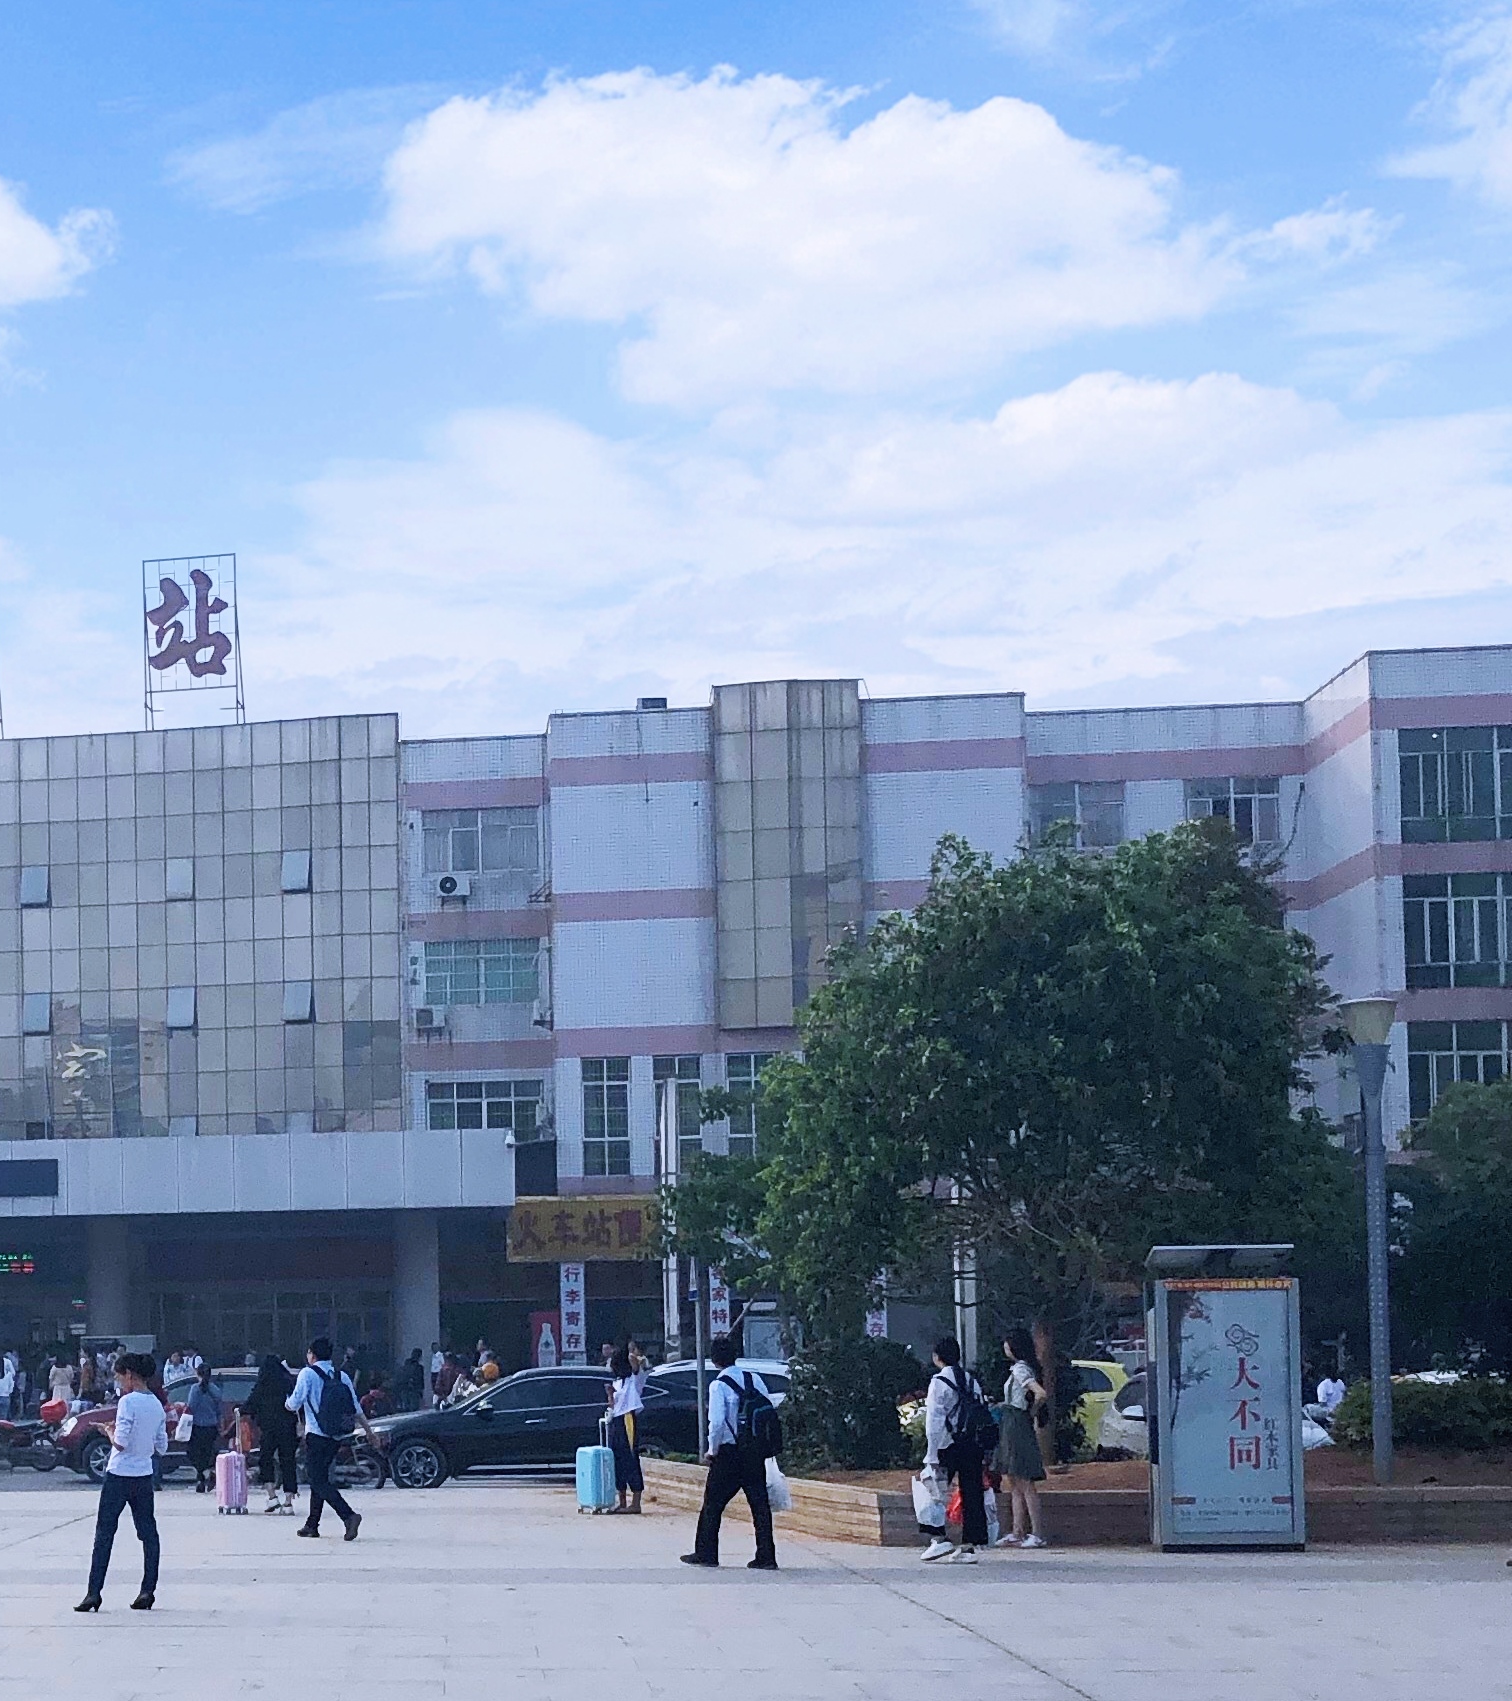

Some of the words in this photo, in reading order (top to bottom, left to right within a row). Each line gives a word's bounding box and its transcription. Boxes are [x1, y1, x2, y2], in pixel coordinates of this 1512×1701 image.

[564, 1266, 582, 1349] 行李寄存
[1228, 1356, 1261, 1471] 大不同
